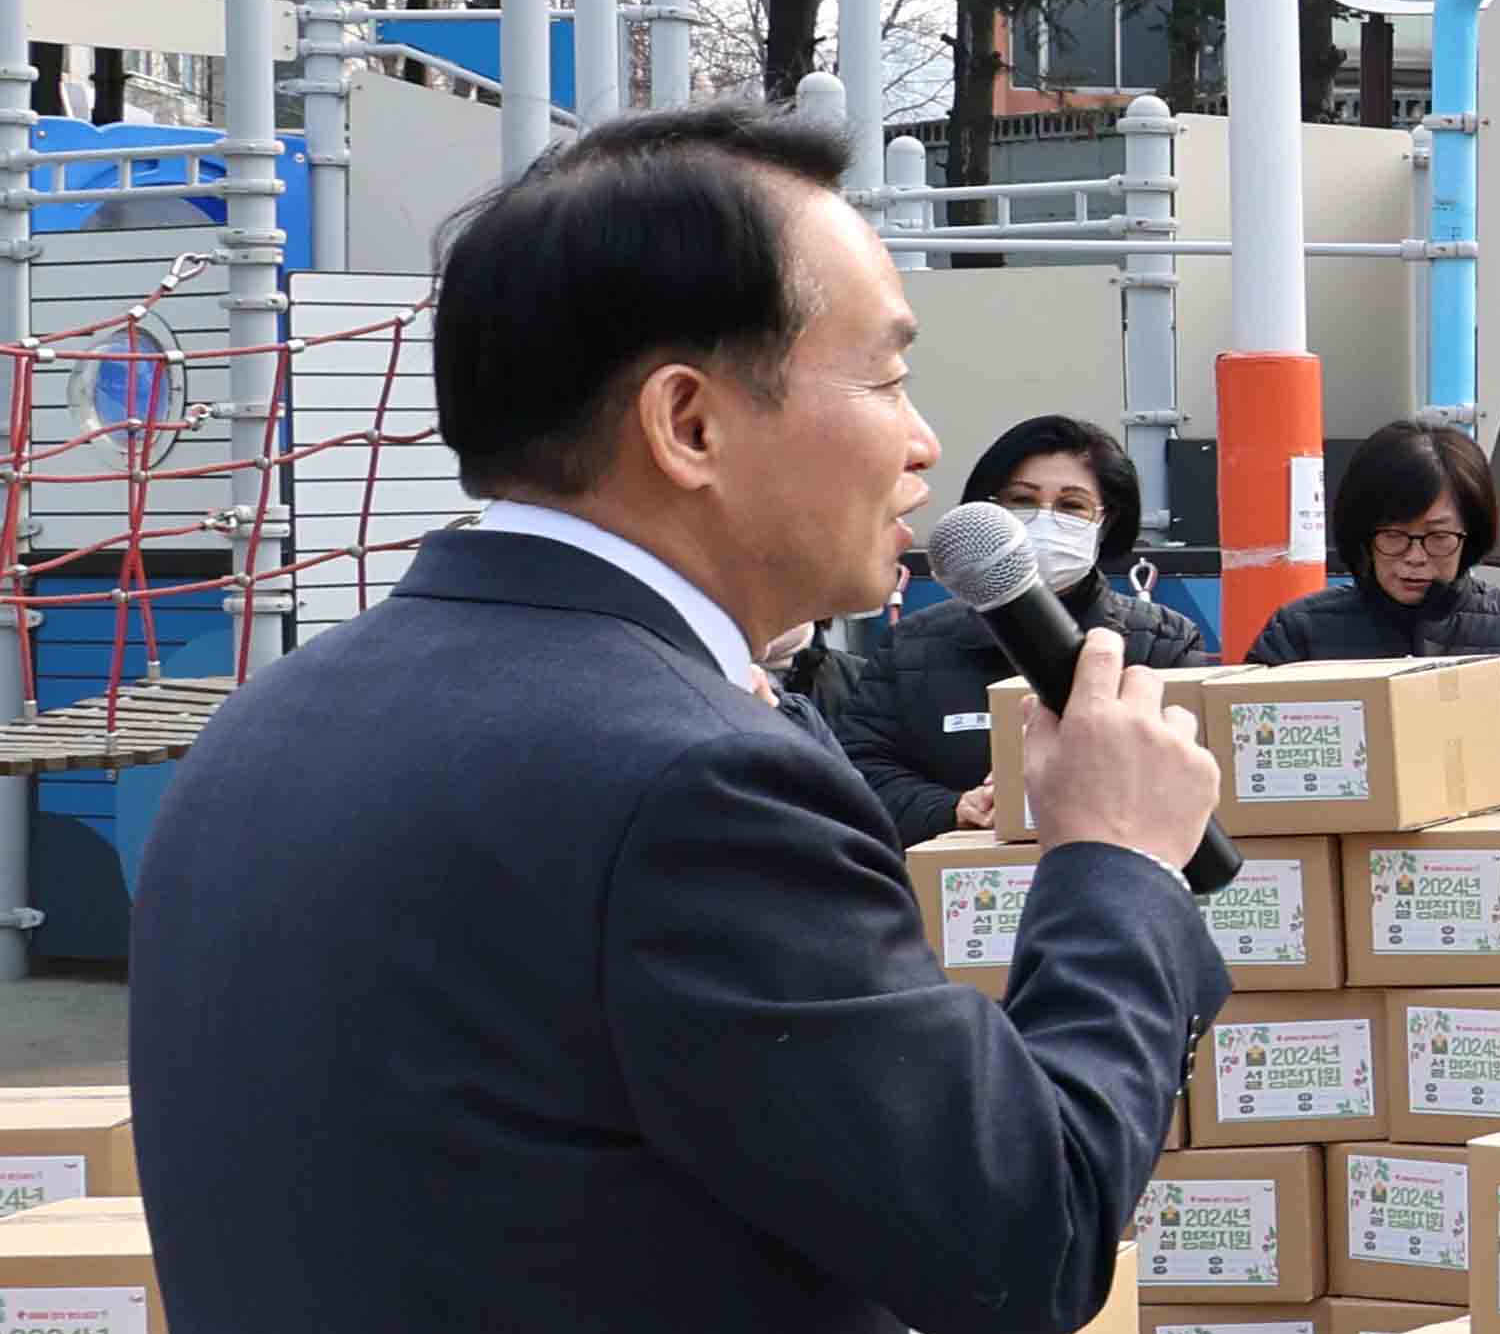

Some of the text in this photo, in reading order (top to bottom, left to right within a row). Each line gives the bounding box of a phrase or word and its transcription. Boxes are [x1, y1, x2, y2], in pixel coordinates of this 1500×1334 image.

[1278, 725, 1341, 745] 2024년
[1255, 747, 1342, 768] 설 명절지원
[1184, 1208, 1251, 1227] 2024년
[1159, 1230, 1251, 1250] 설 명절지원
